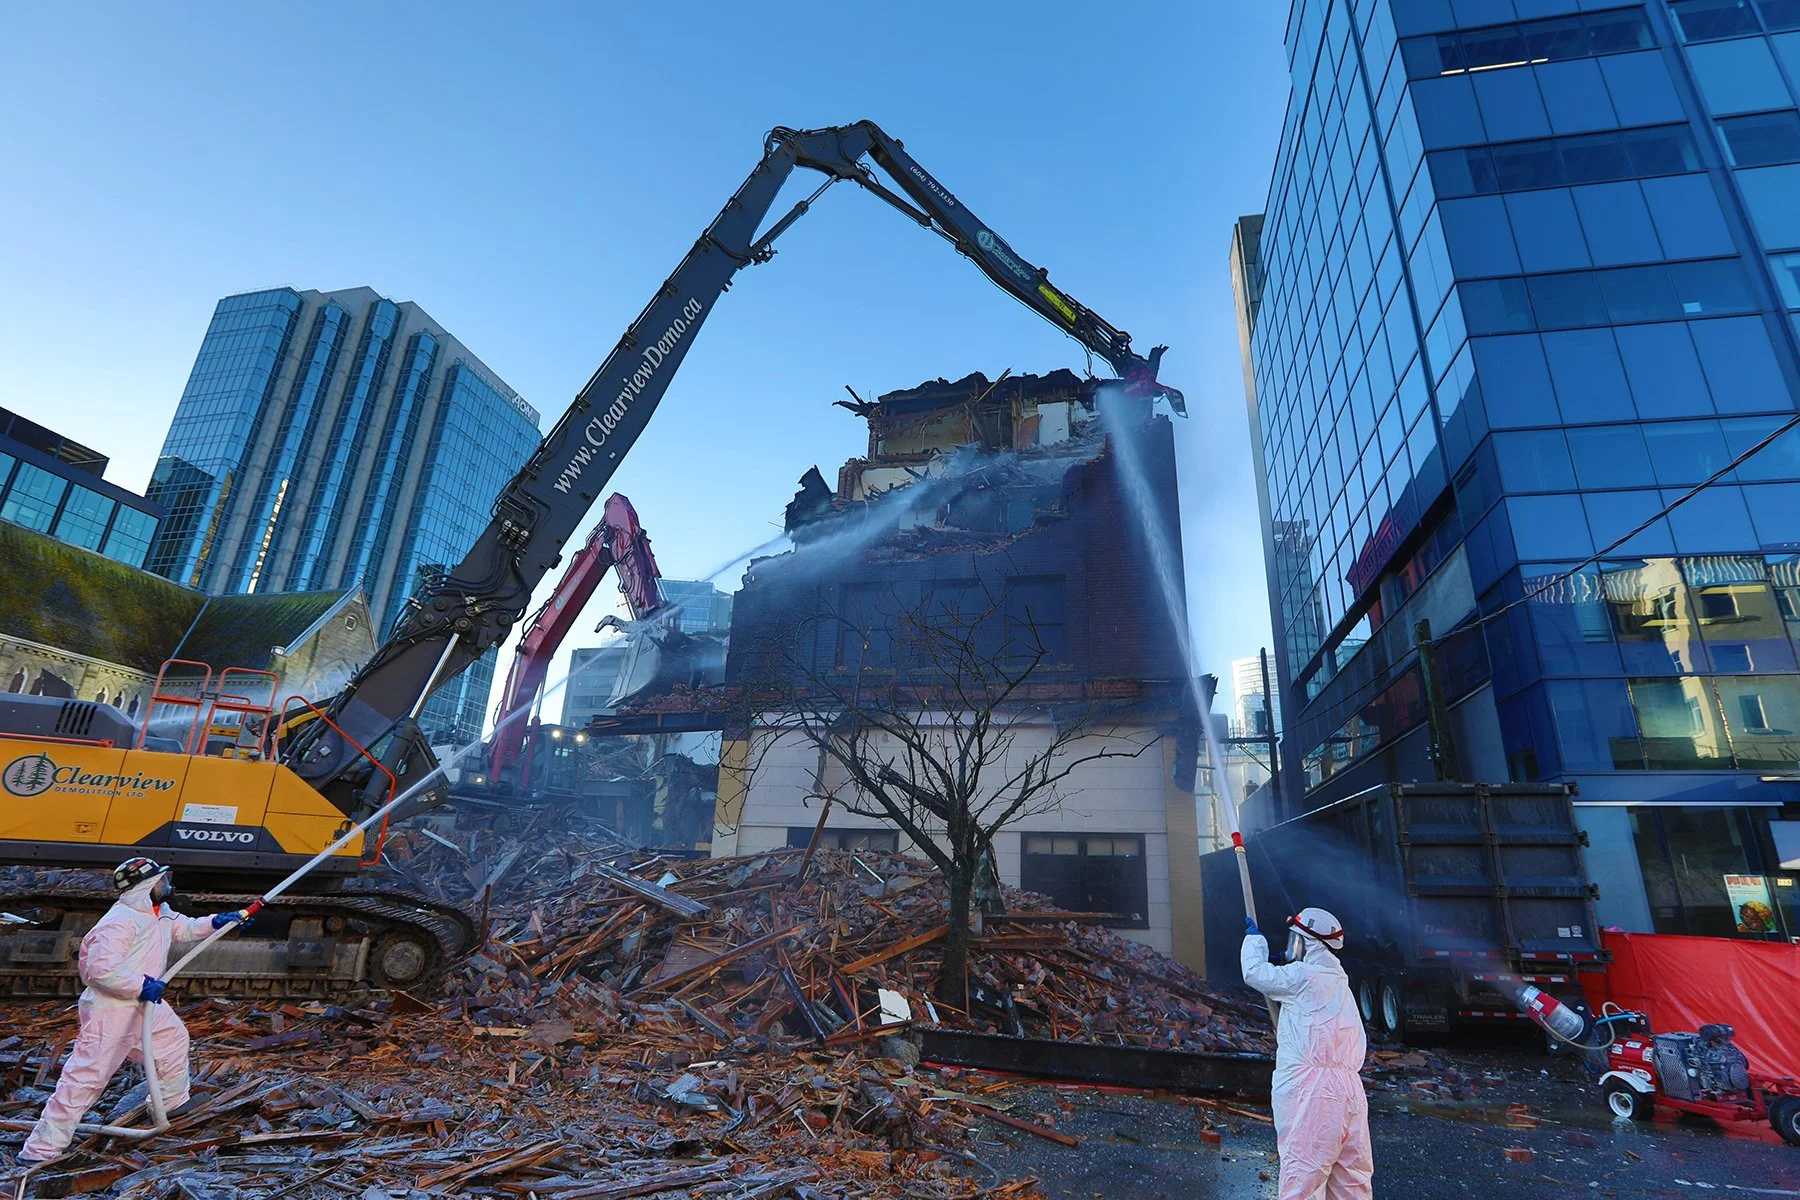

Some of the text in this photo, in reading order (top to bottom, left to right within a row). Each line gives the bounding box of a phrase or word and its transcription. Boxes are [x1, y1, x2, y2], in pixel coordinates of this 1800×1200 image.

[910, 165, 927, 182] (604)
[511, 392, 534, 418] AON
[553, 297, 703, 494] www.ClearviewDemo.ca
[51, 765, 176, 793] Clearview
[54, 785, 147, 799] DEMOLITION LTD.
[175, 828, 255, 844] VOLVO
